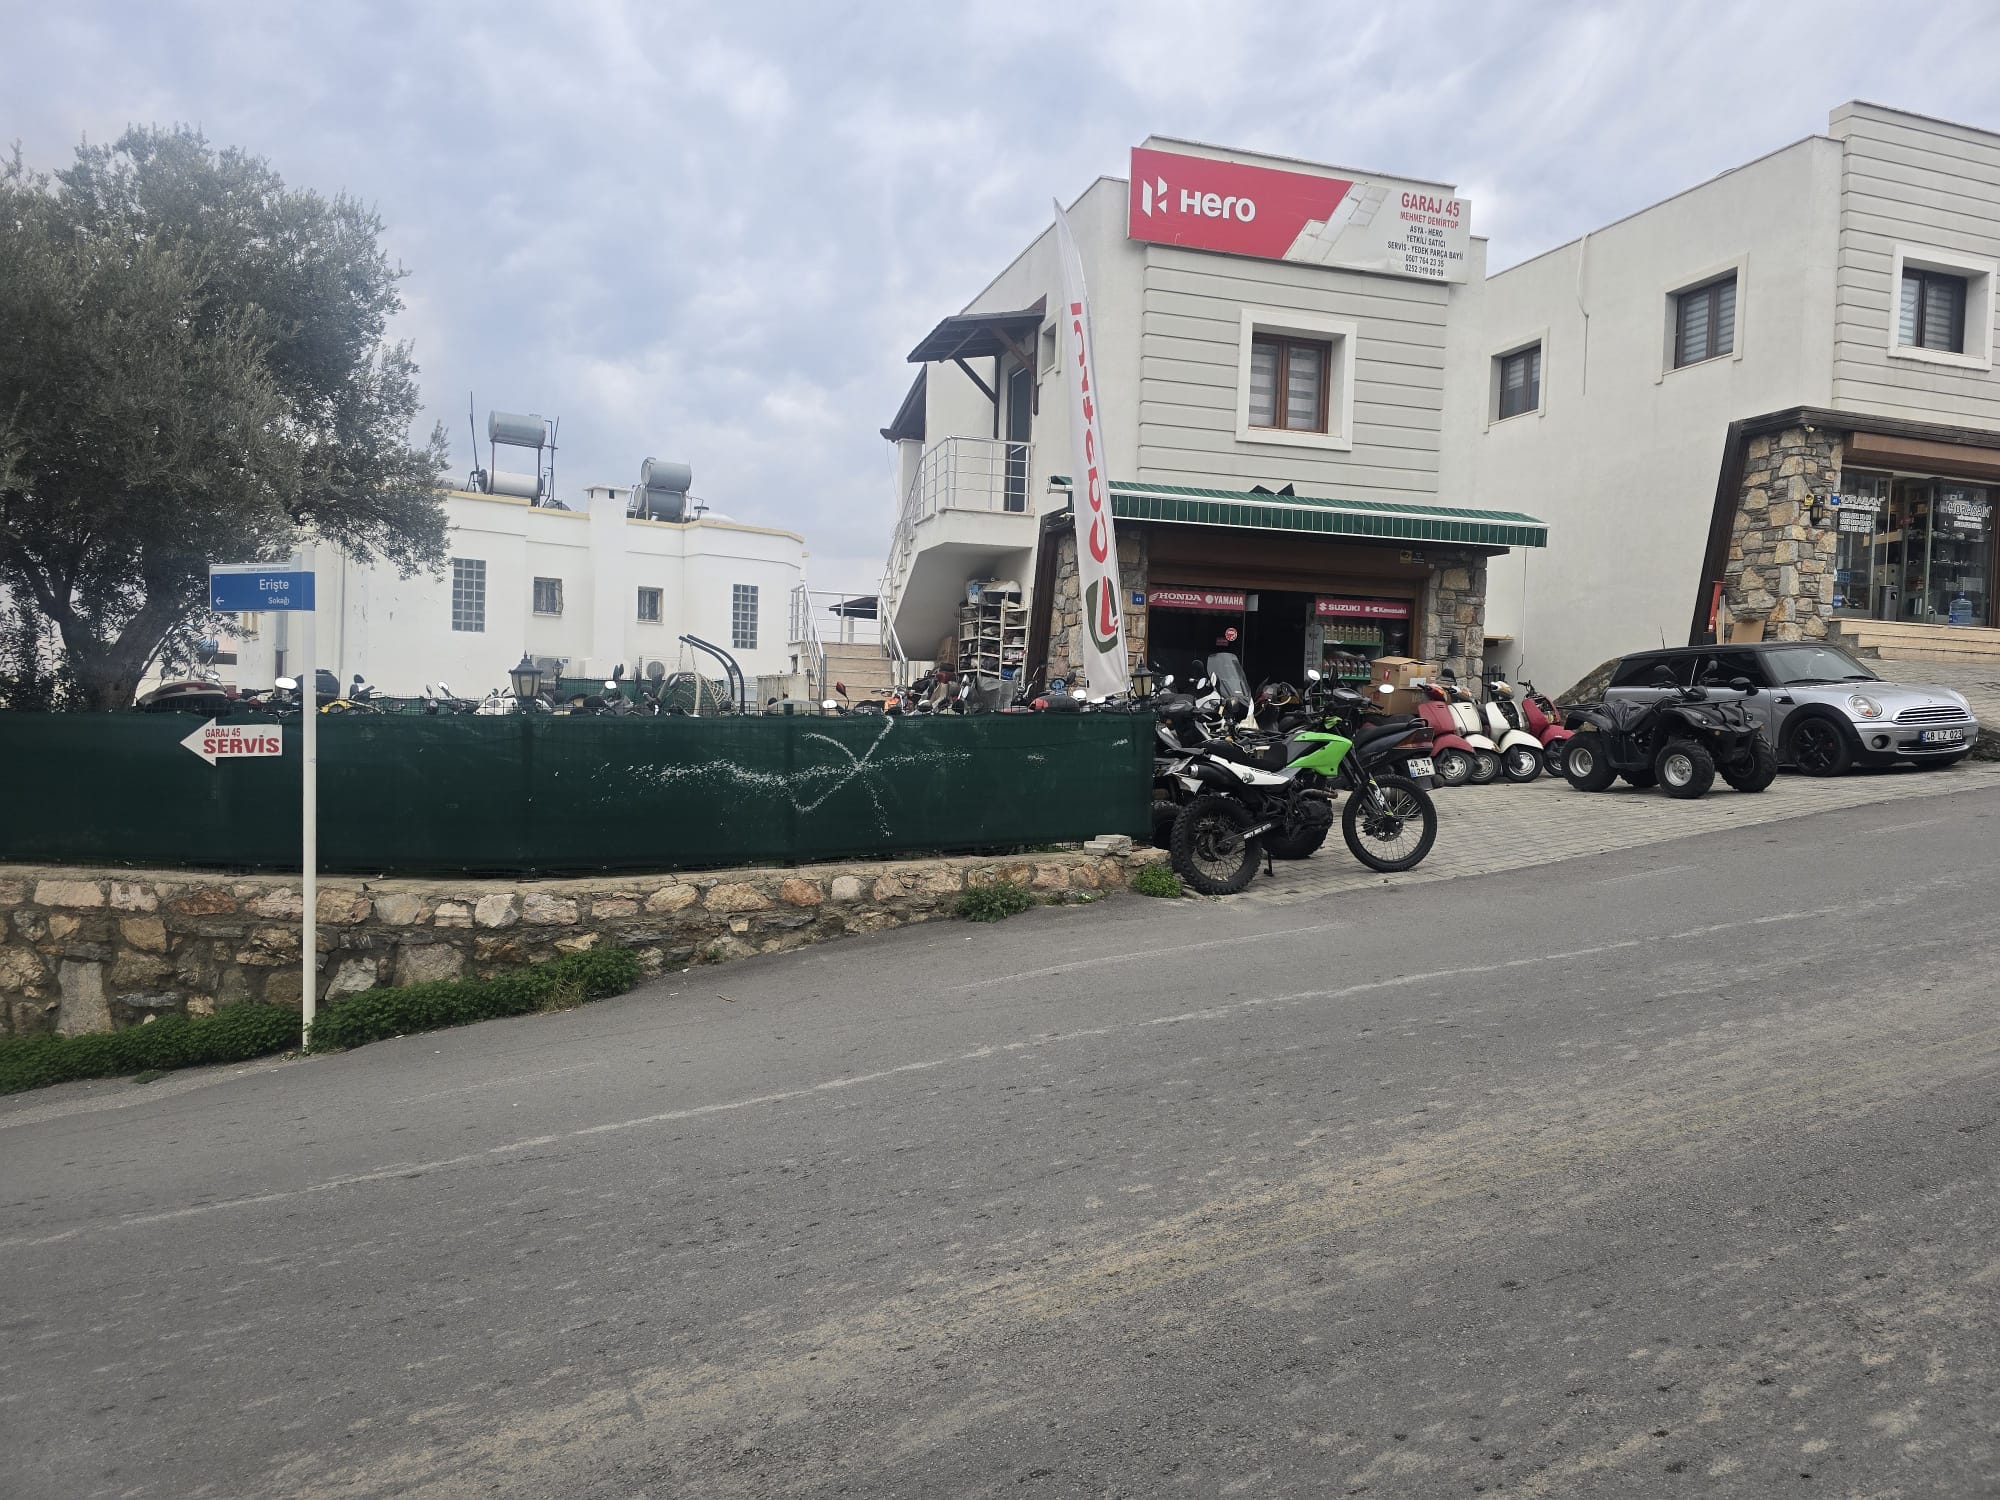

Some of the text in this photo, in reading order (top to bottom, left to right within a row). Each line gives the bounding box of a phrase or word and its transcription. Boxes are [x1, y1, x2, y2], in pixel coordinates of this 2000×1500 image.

[1180, 188, 1256, 222] Hero
[1401, 192, 1460, 217] GARAJ 45
[1400, 211, 1426, 223] MEHMET
[1409, 225, 1424, 234] ASYA
[1428, 228, 1443, 237] HERO
[1428, 238, 1446, 248] SATICI
[1388, 240, 1407, 252] SERVİS
[1411, 245, 1429, 255] YEDEK
[1429, 248, 1448, 260] PARÇA
[1429, 258, 1437, 266] 23
[1405, 264, 1418, 273] 0252
[259, 578, 289, 592] Erişte
[1159, 592, 1244, 605] HONDA YAMAHA
[1328, 604, 1360, 612] SUZUKI
[205, 727, 241, 738] GARAJ 45
[203, 734, 280, 754] SERVİS
[1417, 767, 1430, 775] 254
